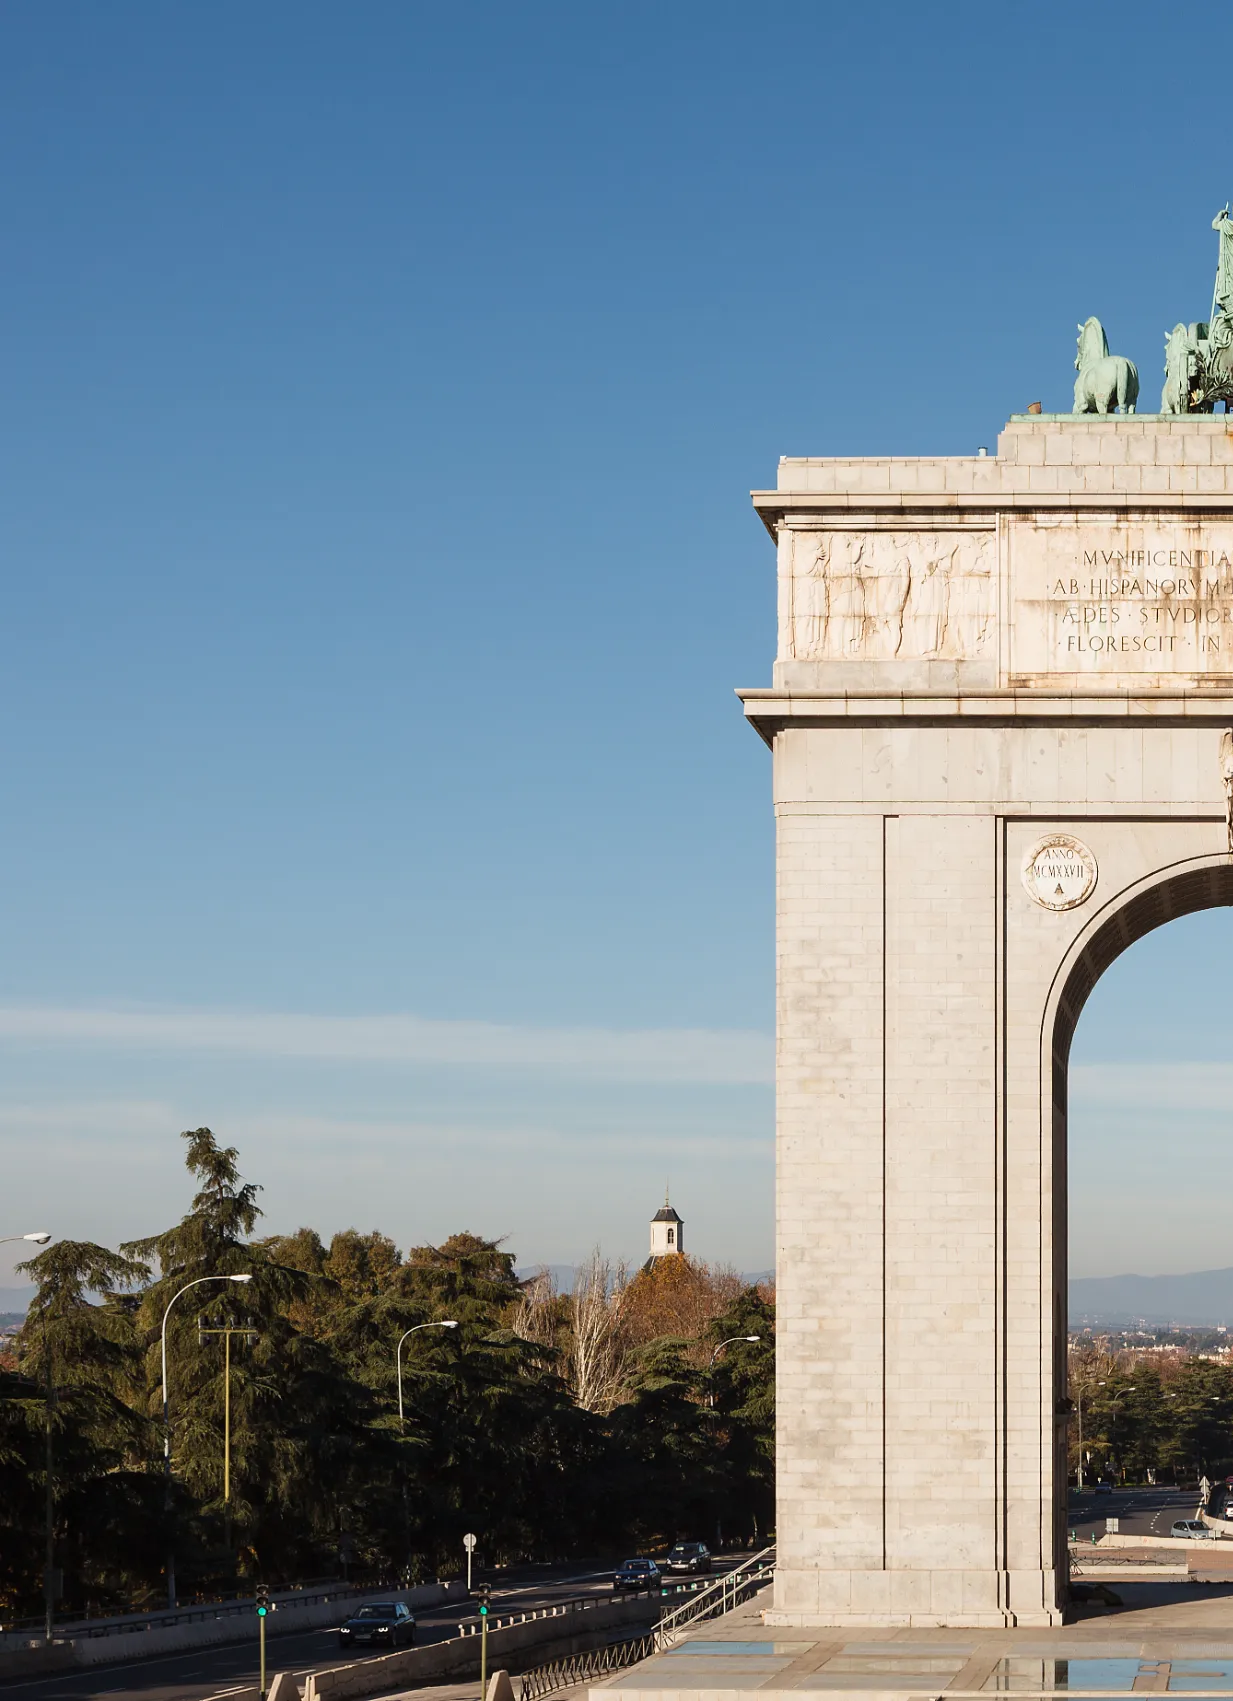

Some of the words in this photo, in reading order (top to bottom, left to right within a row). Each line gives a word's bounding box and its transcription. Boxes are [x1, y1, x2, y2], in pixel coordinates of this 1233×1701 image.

[1083, 550, 1230, 567] MVNIFICENTIA
[1052, 579, 1080, 595] AB
[1090, 579, 1220, 595] HISPANORVM
[1067, 636, 1178, 652] FLORESCIT
[1202, 636, 1220, 652] IN
[1044, 849, 1074, 860] ANNO
[1033, 865, 1084, 878] MCMXXVII
